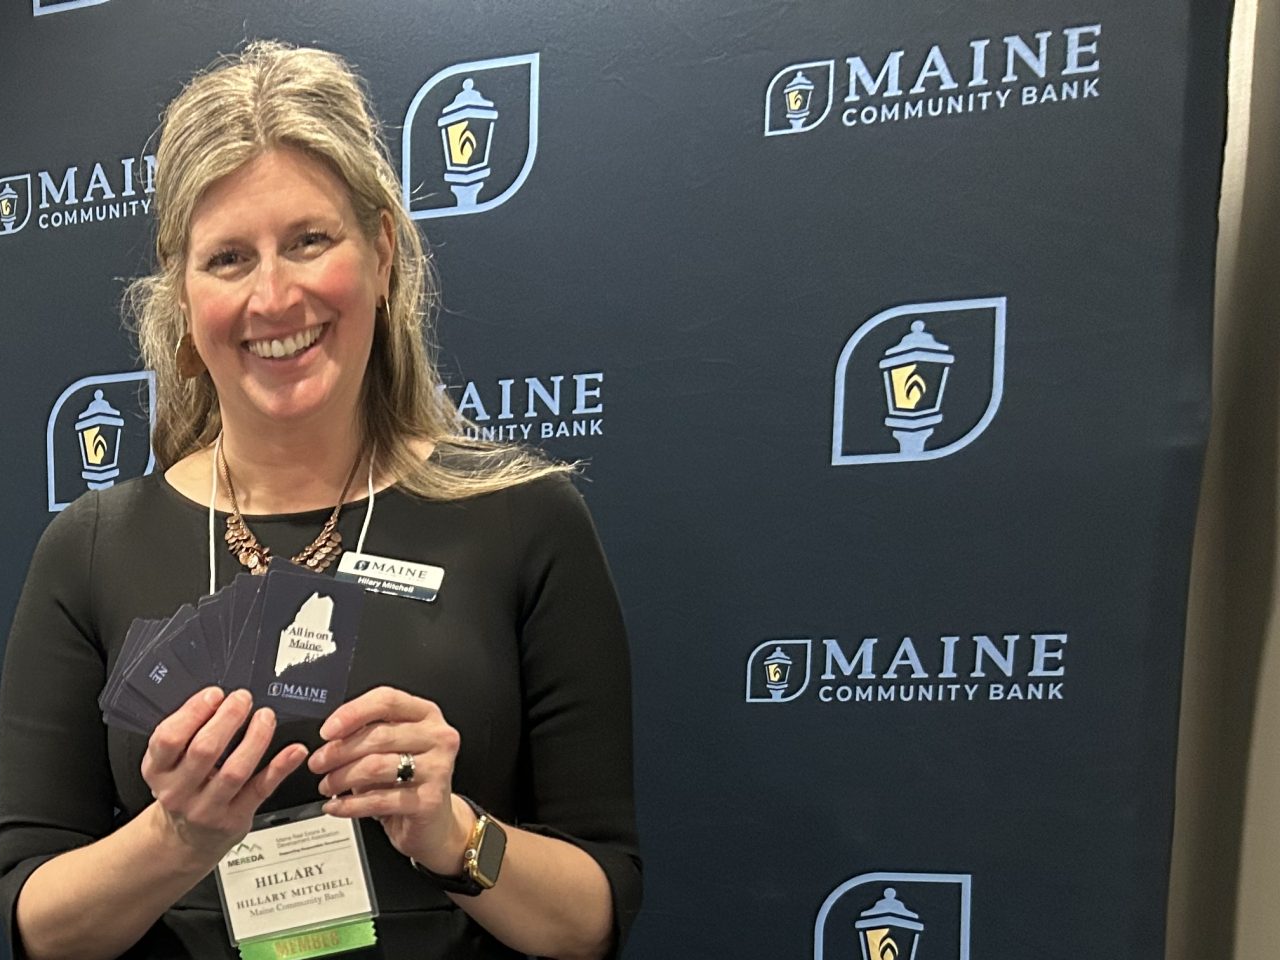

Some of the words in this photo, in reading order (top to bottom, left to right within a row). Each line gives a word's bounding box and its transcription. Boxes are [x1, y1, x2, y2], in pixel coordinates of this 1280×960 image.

[845, 24, 1101, 102] MAINE
[842, 88, 1010, 127] COMMUNITY
[1022, 77, 1100, 105] BANK
[38, 199, 151, 229] COMMUNITY
[454, 373, 604, 421] AINE
[466, 423, 532, 442] UNITY
[541, 419, 603, 438] BANK
[372, 562, 428, 579] MAINE
[382, 581, 415, 593] Mitchell
[288, 627, 304, 636] All
[304, 628, 315, 638] in
[315, 632, 329, 640] on
[288, 639, 323, 652] Maine.
[820, 634, 1067, 680] MAINE
[282, 684, 328, 699] MAINE
[819, 683, 978, 703] COMMUNITY
[989, 682, 1063, 700] BANK
[227, 854, 264, 868] MEREDA
[255, 862, 326, 888] HILLARY
[236, 892, 287, 909] HILLARY
[291, 877, 353, 897] MITCHELL
[249, 903, 275, 917] Maine
[276, 897, 322, 912] Community
[324, 891, 345, 902] Bank
